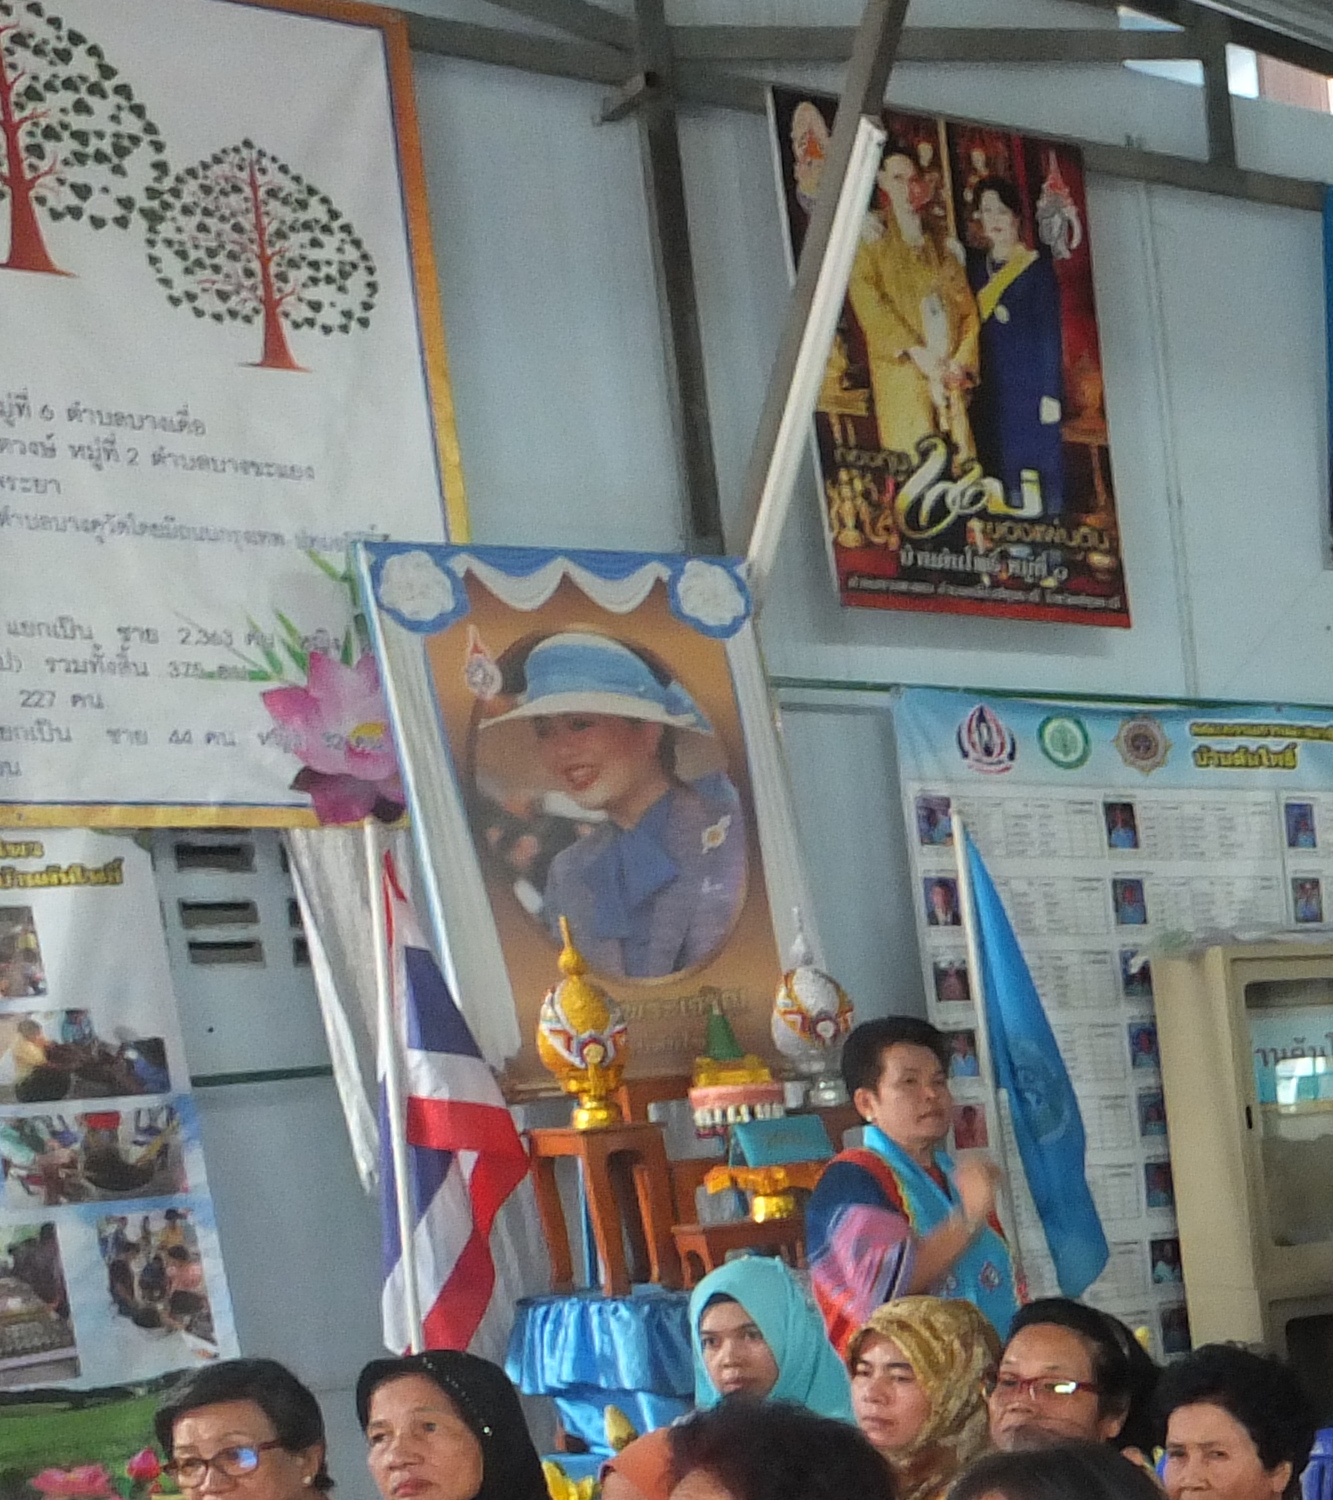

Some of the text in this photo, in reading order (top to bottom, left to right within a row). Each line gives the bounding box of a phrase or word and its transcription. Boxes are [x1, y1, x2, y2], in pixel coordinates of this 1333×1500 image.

[127, 447, 139, 466] 2
[116, 626, 159, 644] ชาย
[20, 689, 104, 709] 227 คน
[106, 728, 148, 745] ชาย
[204, 730, 237, 747] คน
